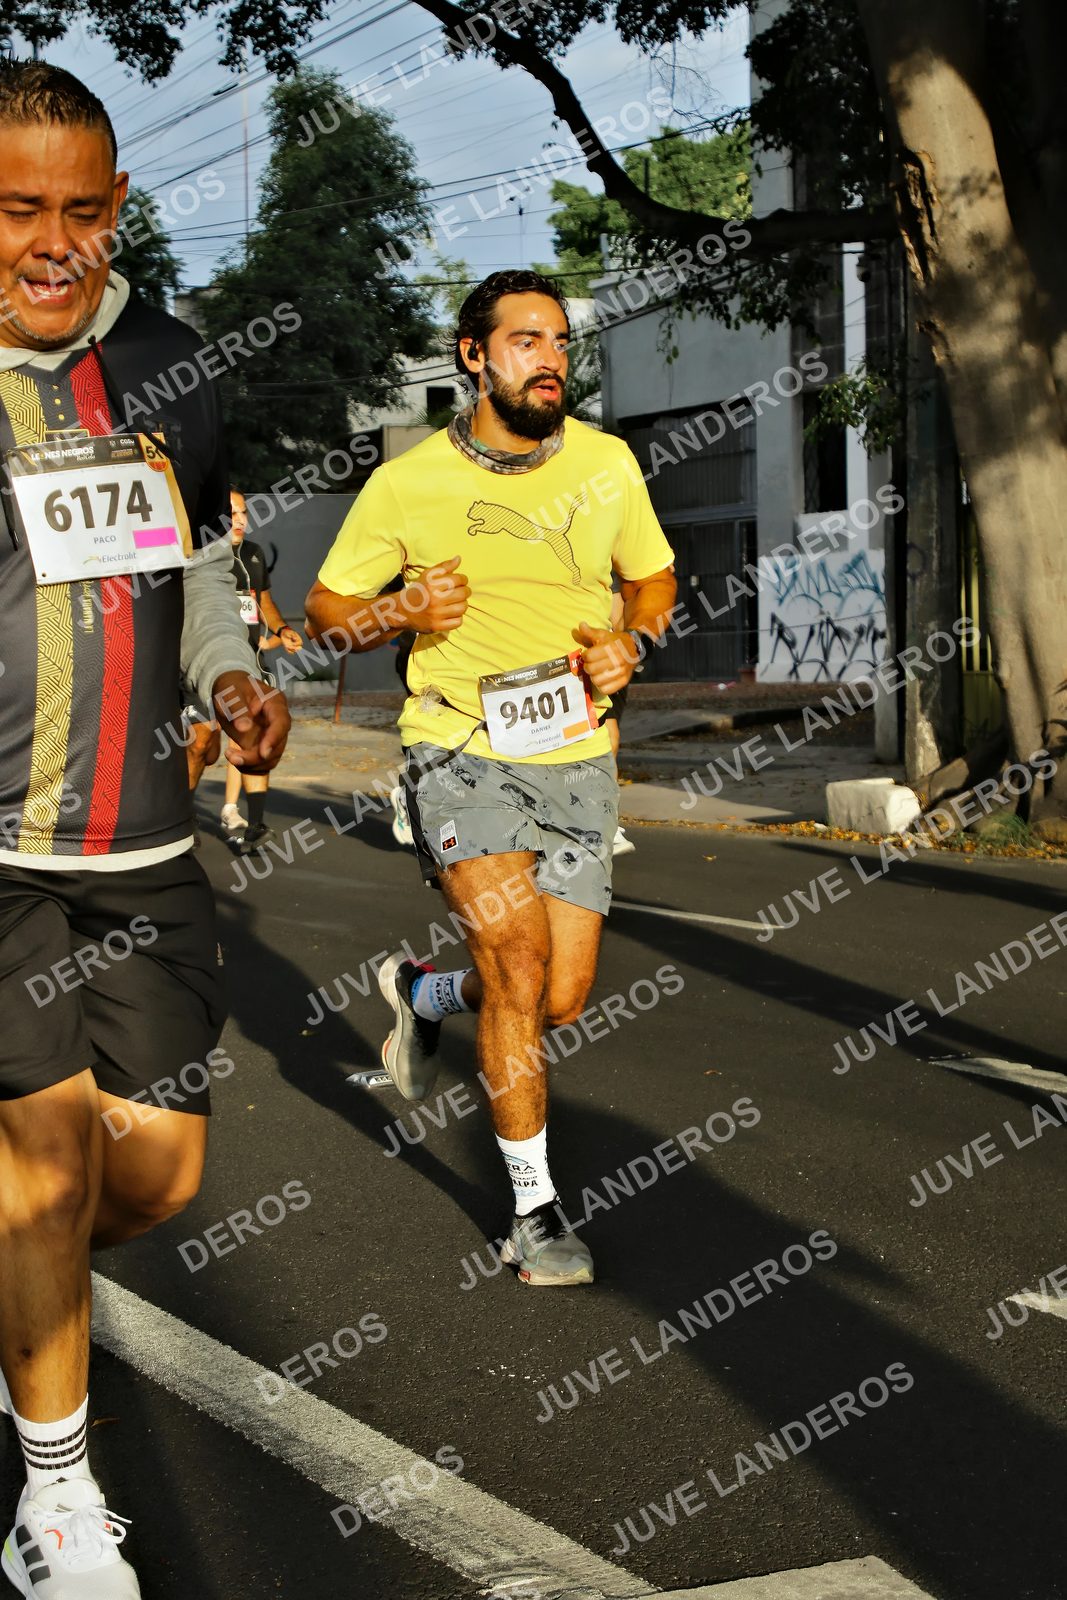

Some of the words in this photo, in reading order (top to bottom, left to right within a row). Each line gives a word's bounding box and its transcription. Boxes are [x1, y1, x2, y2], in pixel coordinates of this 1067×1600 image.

[62, 446, 94, 457] NEGROS
[44, 480, 152, 532] 6174
[93, 535, 116, 545] PACO
[499, 685, 570, 730] 9401
